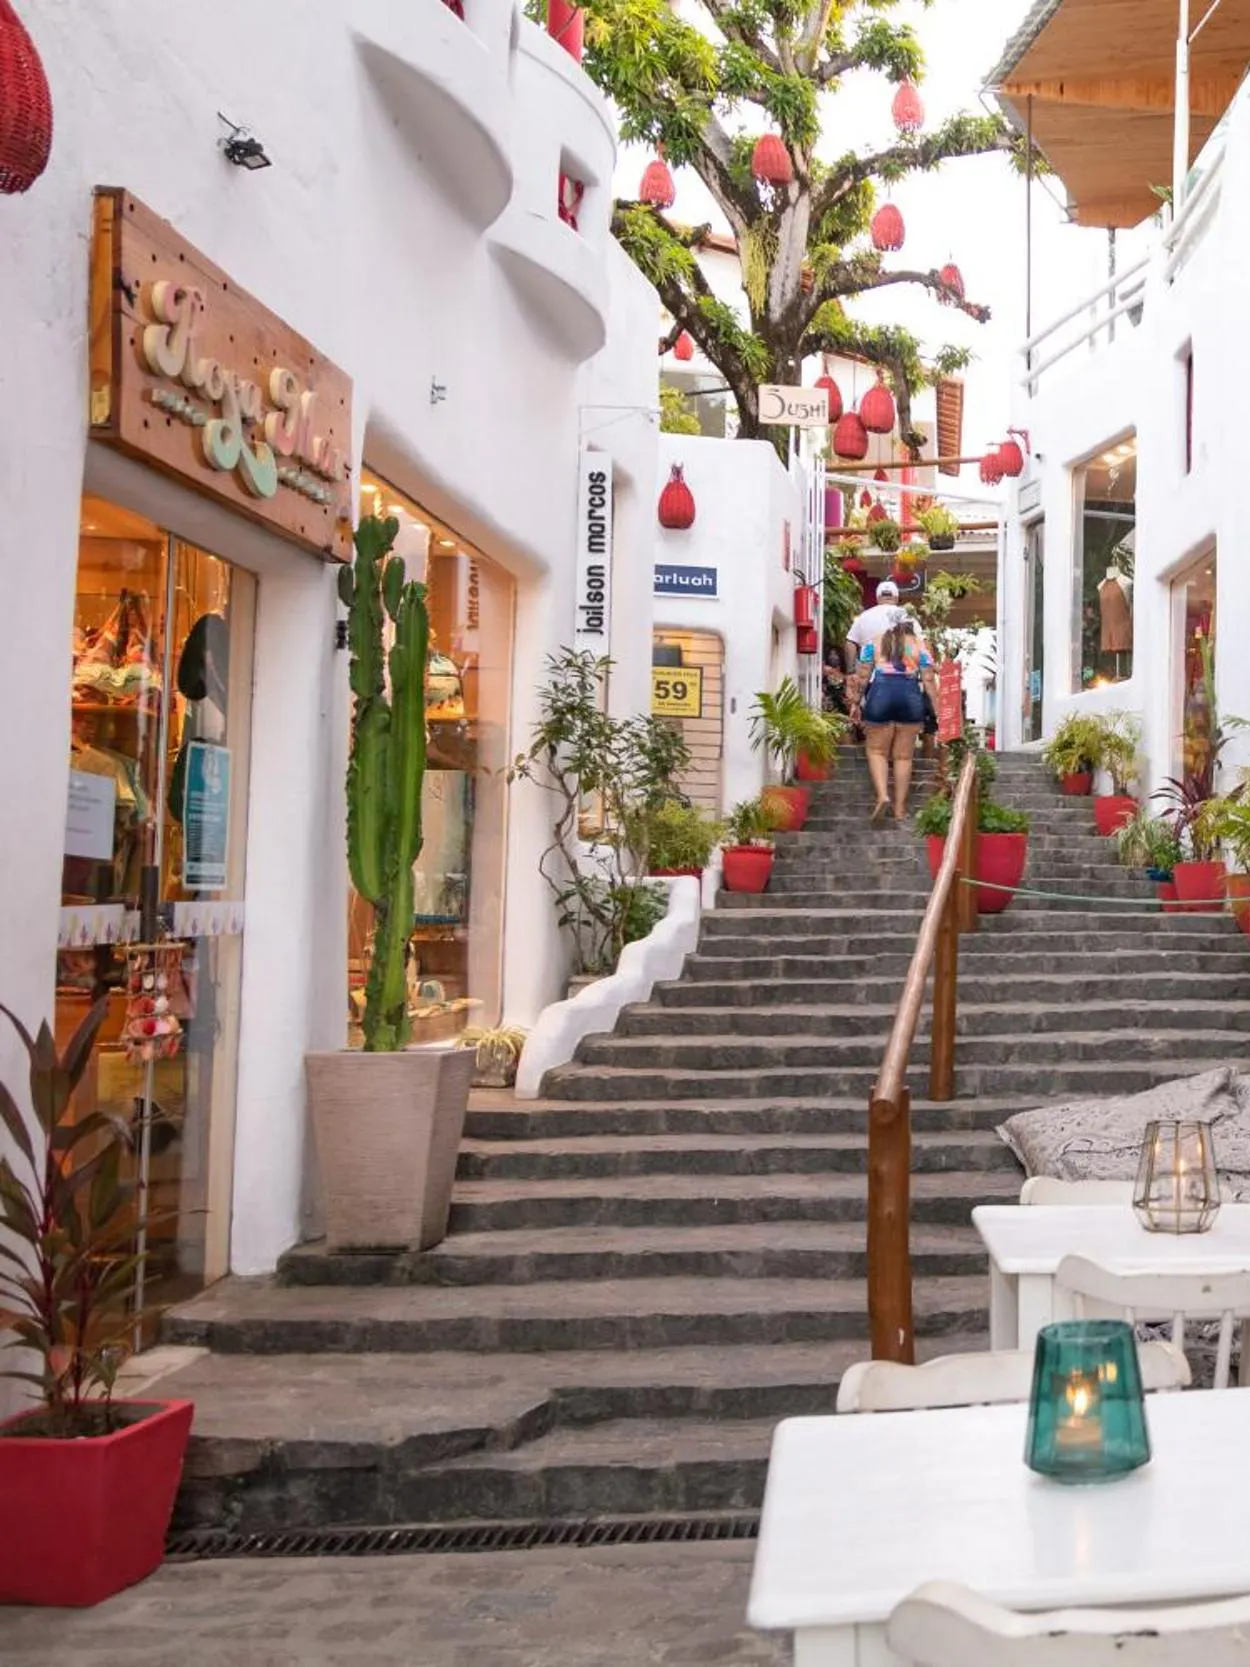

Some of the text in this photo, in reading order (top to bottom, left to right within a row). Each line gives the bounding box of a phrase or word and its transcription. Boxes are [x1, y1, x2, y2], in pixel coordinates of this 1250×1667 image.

[576, 471, 608, 637] jailson marcos
[654, 680, 688, 700] 59
